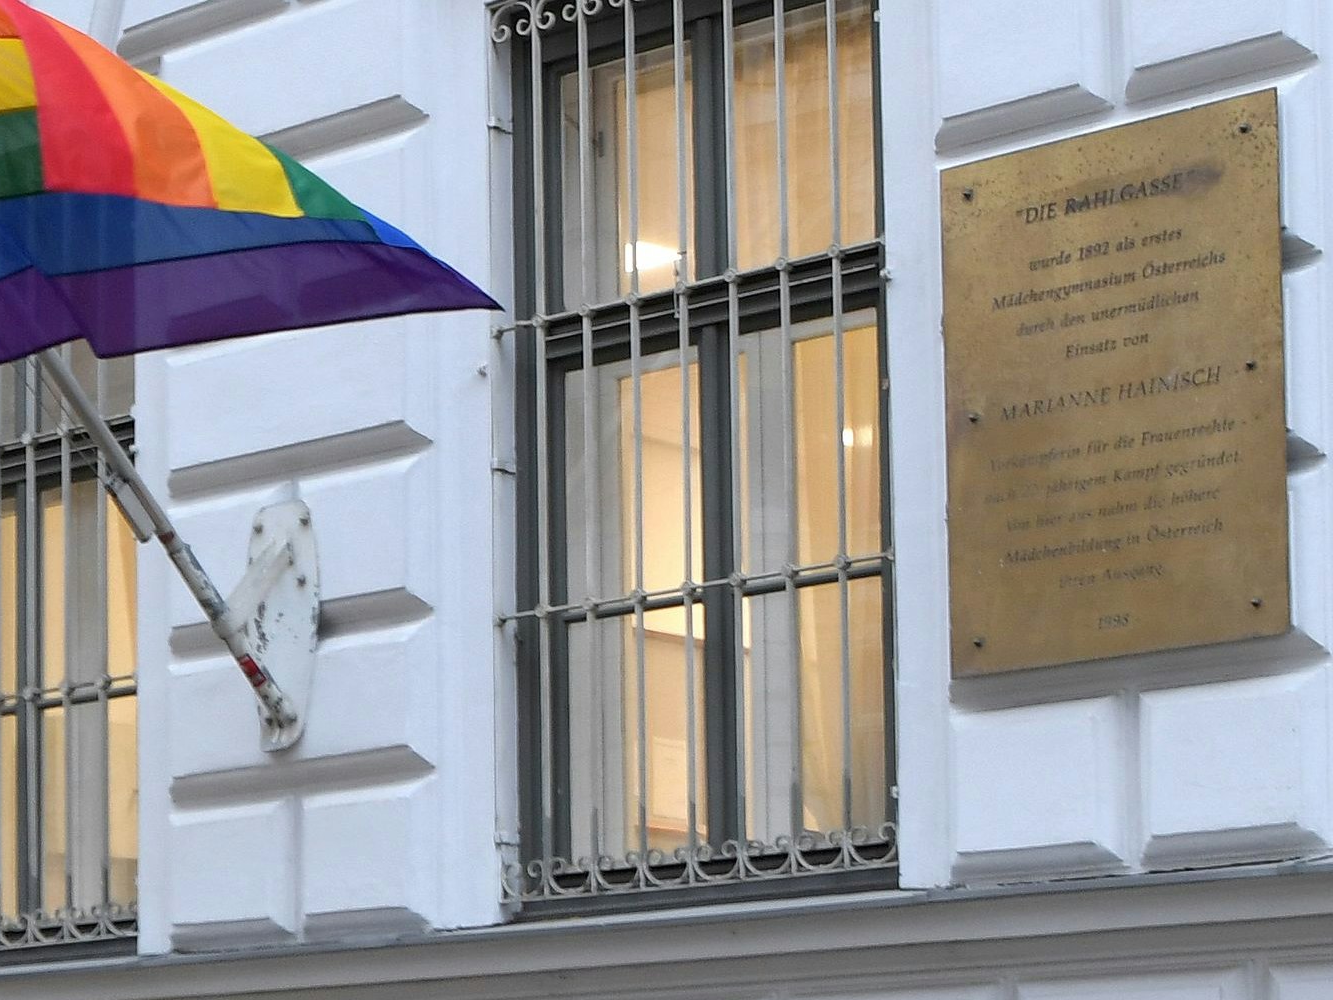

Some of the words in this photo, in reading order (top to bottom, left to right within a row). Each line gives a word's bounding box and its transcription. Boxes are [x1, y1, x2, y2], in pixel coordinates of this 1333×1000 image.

[1029, 251, 1071, 271] wurde
[1079, 241, 1110, 261] 1892
[1116, 237, 1135, 252] als
[1141, 228, 1182, 248] erstes
[992, 271, 1135, 311] Mädchengymnasium
[1142, 250, 1226, 279] Österreichs
[1017, 318, 1055, 336] durch
[1060, 312, 1085, 328] den
[1091, 290, 1199, 321] unermüdlichen
[1066, 338, 1117, 358] Einsatz
[1123, 332, 1149, 347] von
[1001, 387, 1111, 421] MARIANNE
[1118, 366, 1221, 400] HAINISCH
[1087, 440, 1110, 455] für
[1113, 436, 1135, 450] die
[1141, 418, 1235, 447] Frauenrechte
[1113, 462, 1160, 482] Kampf
[1126, 534, 1140, 547] in
[1147, 517, 1223, 543] Österreich
